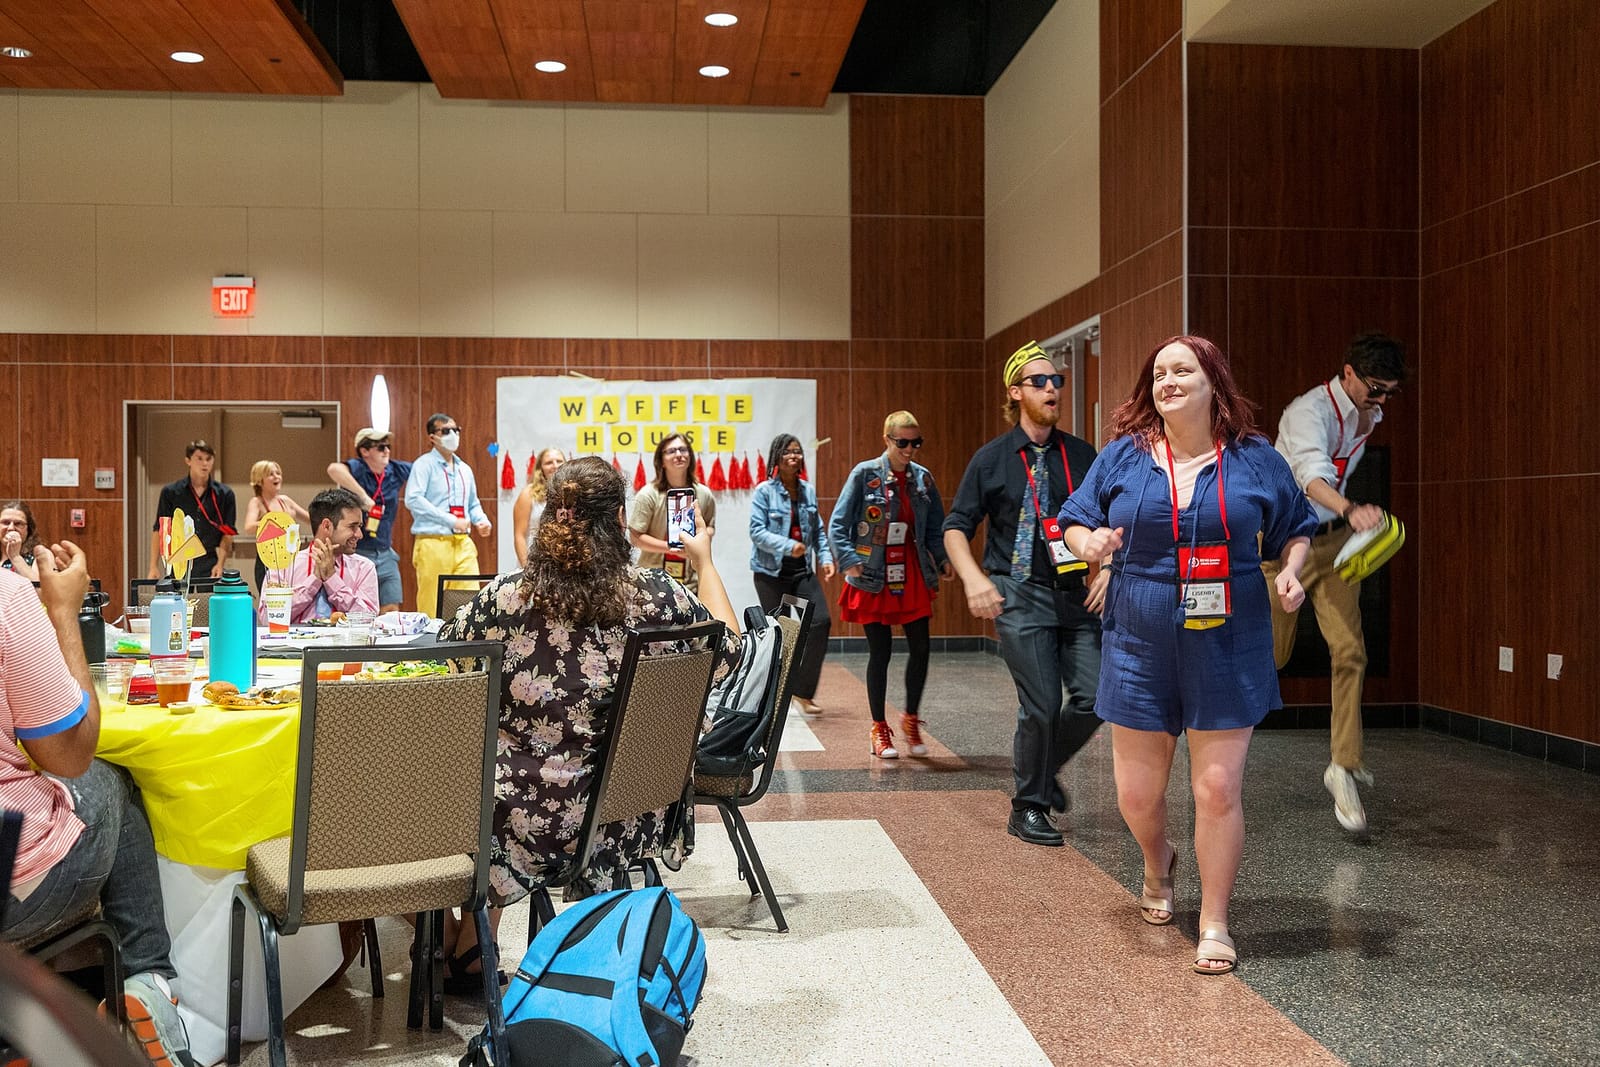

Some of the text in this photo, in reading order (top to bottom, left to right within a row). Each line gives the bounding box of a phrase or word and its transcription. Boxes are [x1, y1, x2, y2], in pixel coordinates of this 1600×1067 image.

[220, 288, 249, 311] EXIT
[563, 399, 745, 417] WAFFLE
[584, 430, 727, 447] HOUSE
